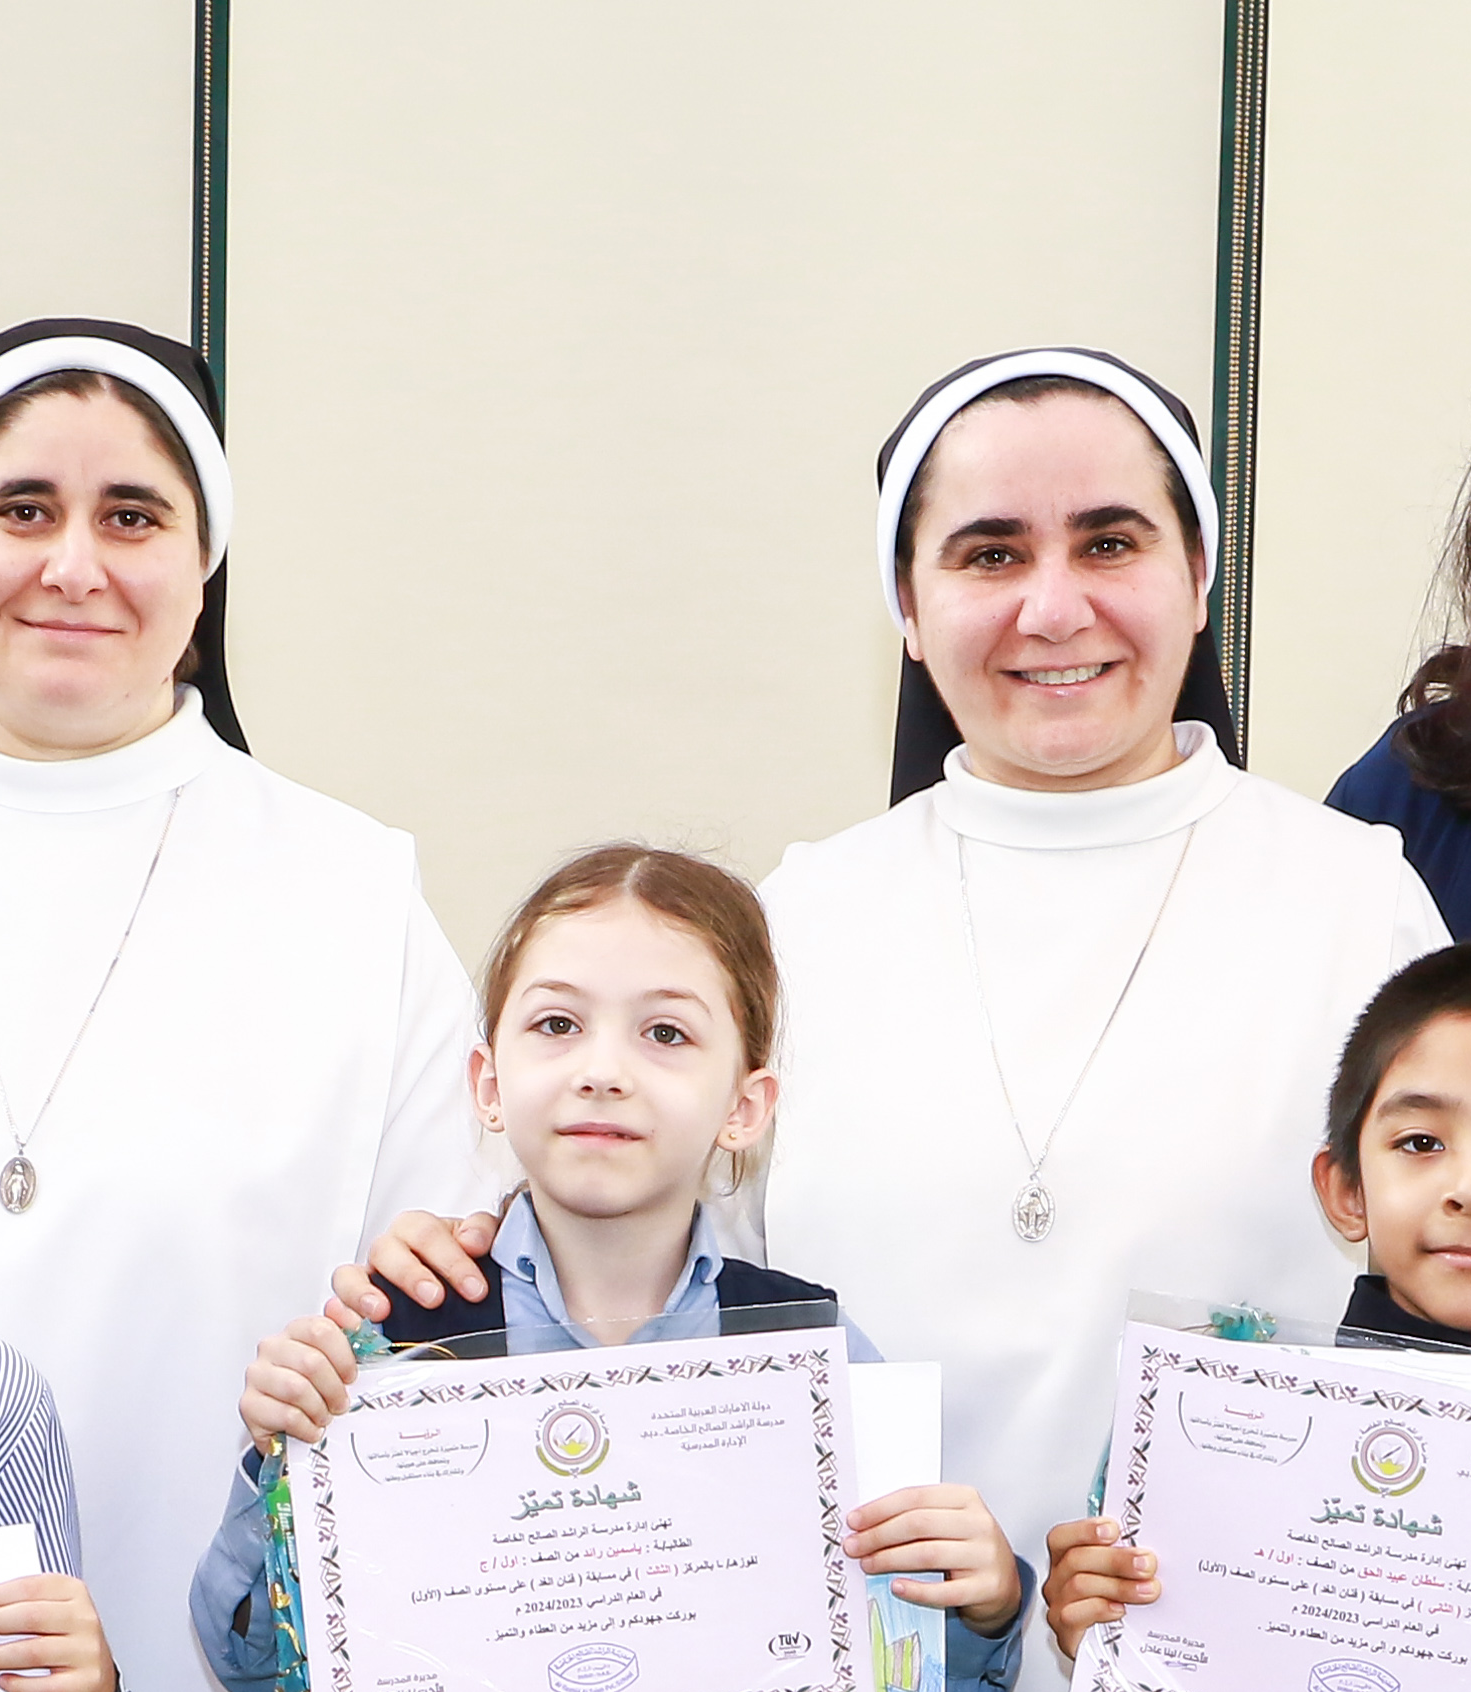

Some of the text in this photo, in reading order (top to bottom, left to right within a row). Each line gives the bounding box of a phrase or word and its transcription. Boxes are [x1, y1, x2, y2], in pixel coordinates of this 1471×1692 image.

[568, 1480, 642, 1511] شهادة
[590, 1522, 625, 1536] مدرسة
[1371, 1507, 1443, 1539] شهادة
[491, 1532, 525, 1545] الخاصة
[527, 1528, 559, 1546] الصالح
[560, 1525, 589, 1539] الراشد
[1286, 1528, 1320, 1545] الخاصة
[605, 1542, 643, 1559] ياسمين
[1320, 1537, 1352, 1551] الصالح
[1353, 1542, 1383, 1558] الراشد
[529, 1549, 561, 1564] الصف
[563, 1550, 580, 1563] من
[1384, 1545, 1418, 1562] مدرسة
[681, 1559, 715, 1575] بالمركز
[1305, 1555, 1337, 1570] الصف
[1338, 1563, 1356, 1576] من
[585, 1570, 617, 1583] مسابقة
[618, 1566, 632, 1583] في
[1228, 1566, 1256, 1579] الصف
[1356, 1566, 1383, 1579] الحق
[1410, 1573, 1446, 1588] سلطان
[443, 1584, 472, 1597] الصف
[648, 1586, 663, 1602] في
[1367, 1589, 1400, 1605] مسابقة
[585, 1591, 624, 1610] الدراسي
[1400, 1596, 1415, 1611] في
[627, 1614, 664, 1628] جهودكم
[665, 1609, 697, 1622] بوركت
[528, 1622, 557, 1636] العطاء
[559, 1623, 575, 1635] من
[576, 1619, 598, 1632] مزيد
[1361, 1616, 1401, 1630] الدراسي
[1299, 1626, 1328, 1640] العطاء
[1424, 1623, 1440, 1638] في
[1329, 1633, 1345, 1645] من
[1346, 1636, 1369, 1650] مزيد
[1397, 1644, 1435, 1660] جهودكم
[1436, 1650, 1469, 1666] بوركت
